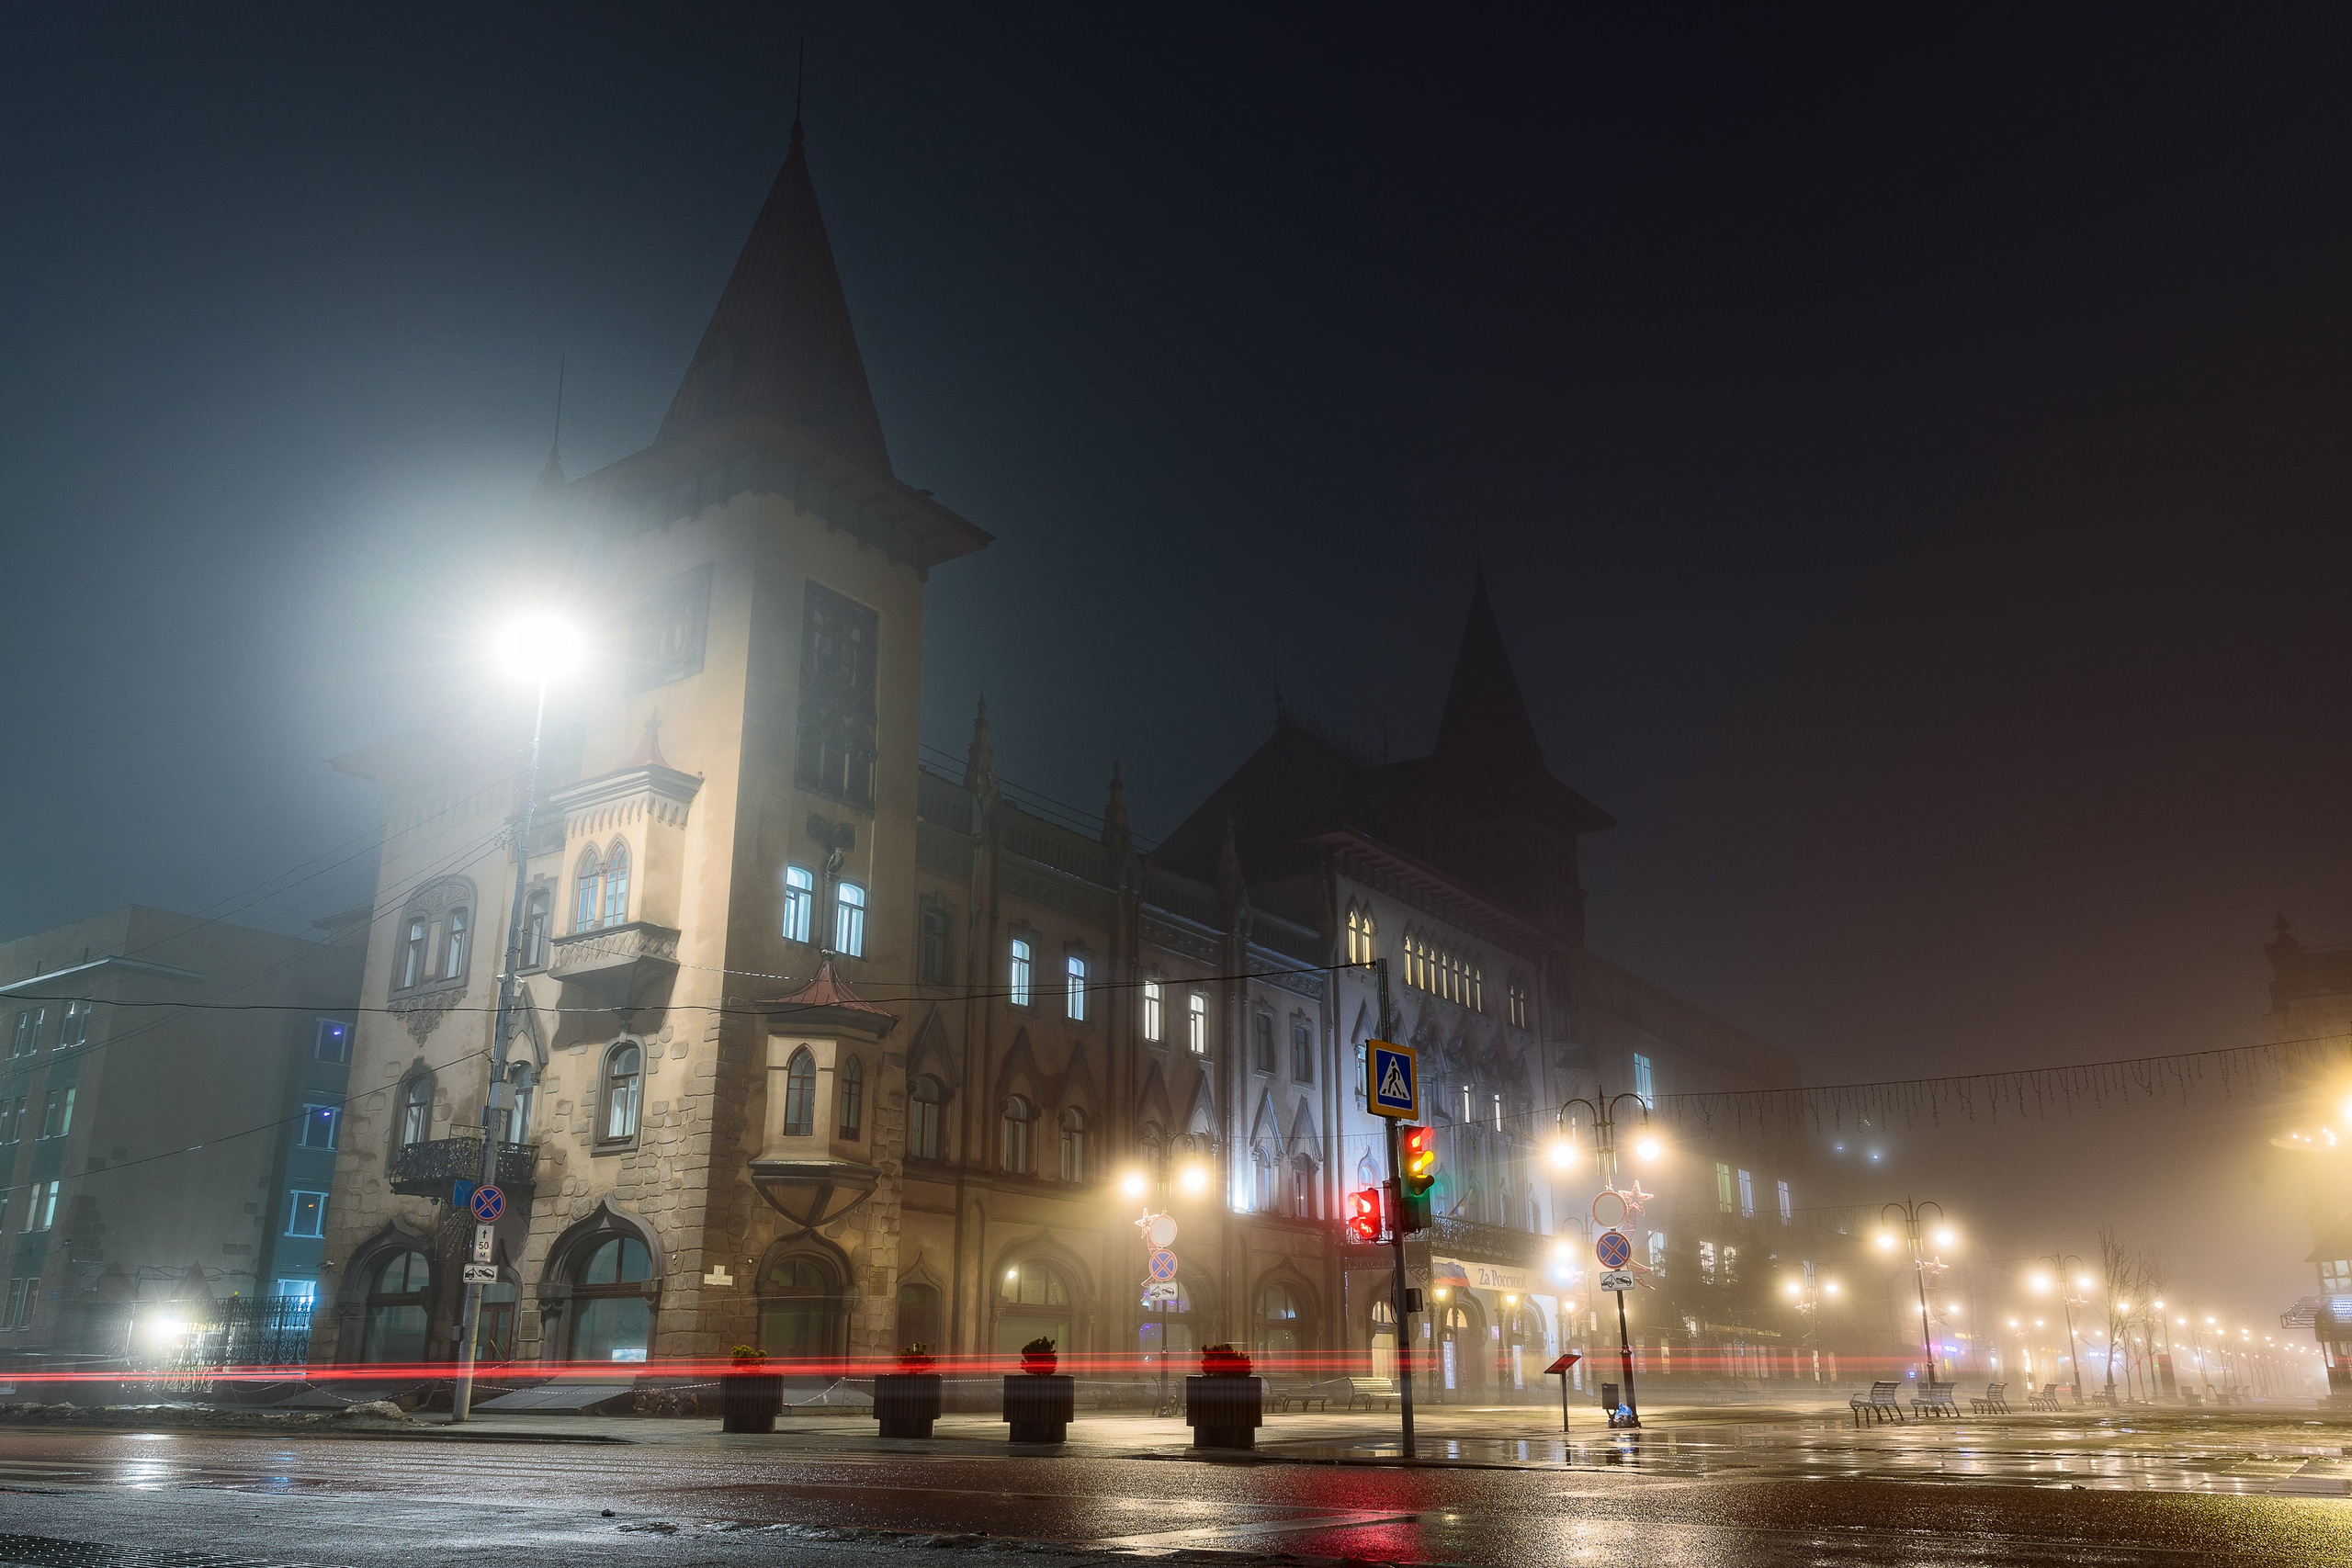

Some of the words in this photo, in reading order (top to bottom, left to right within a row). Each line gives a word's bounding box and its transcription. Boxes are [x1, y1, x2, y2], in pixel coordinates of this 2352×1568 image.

[479, 1242, 489, 1250] 50
[1478, 1268, 1490, 1285] Za
[1491, 1269, 1527, 1290] Россию!
